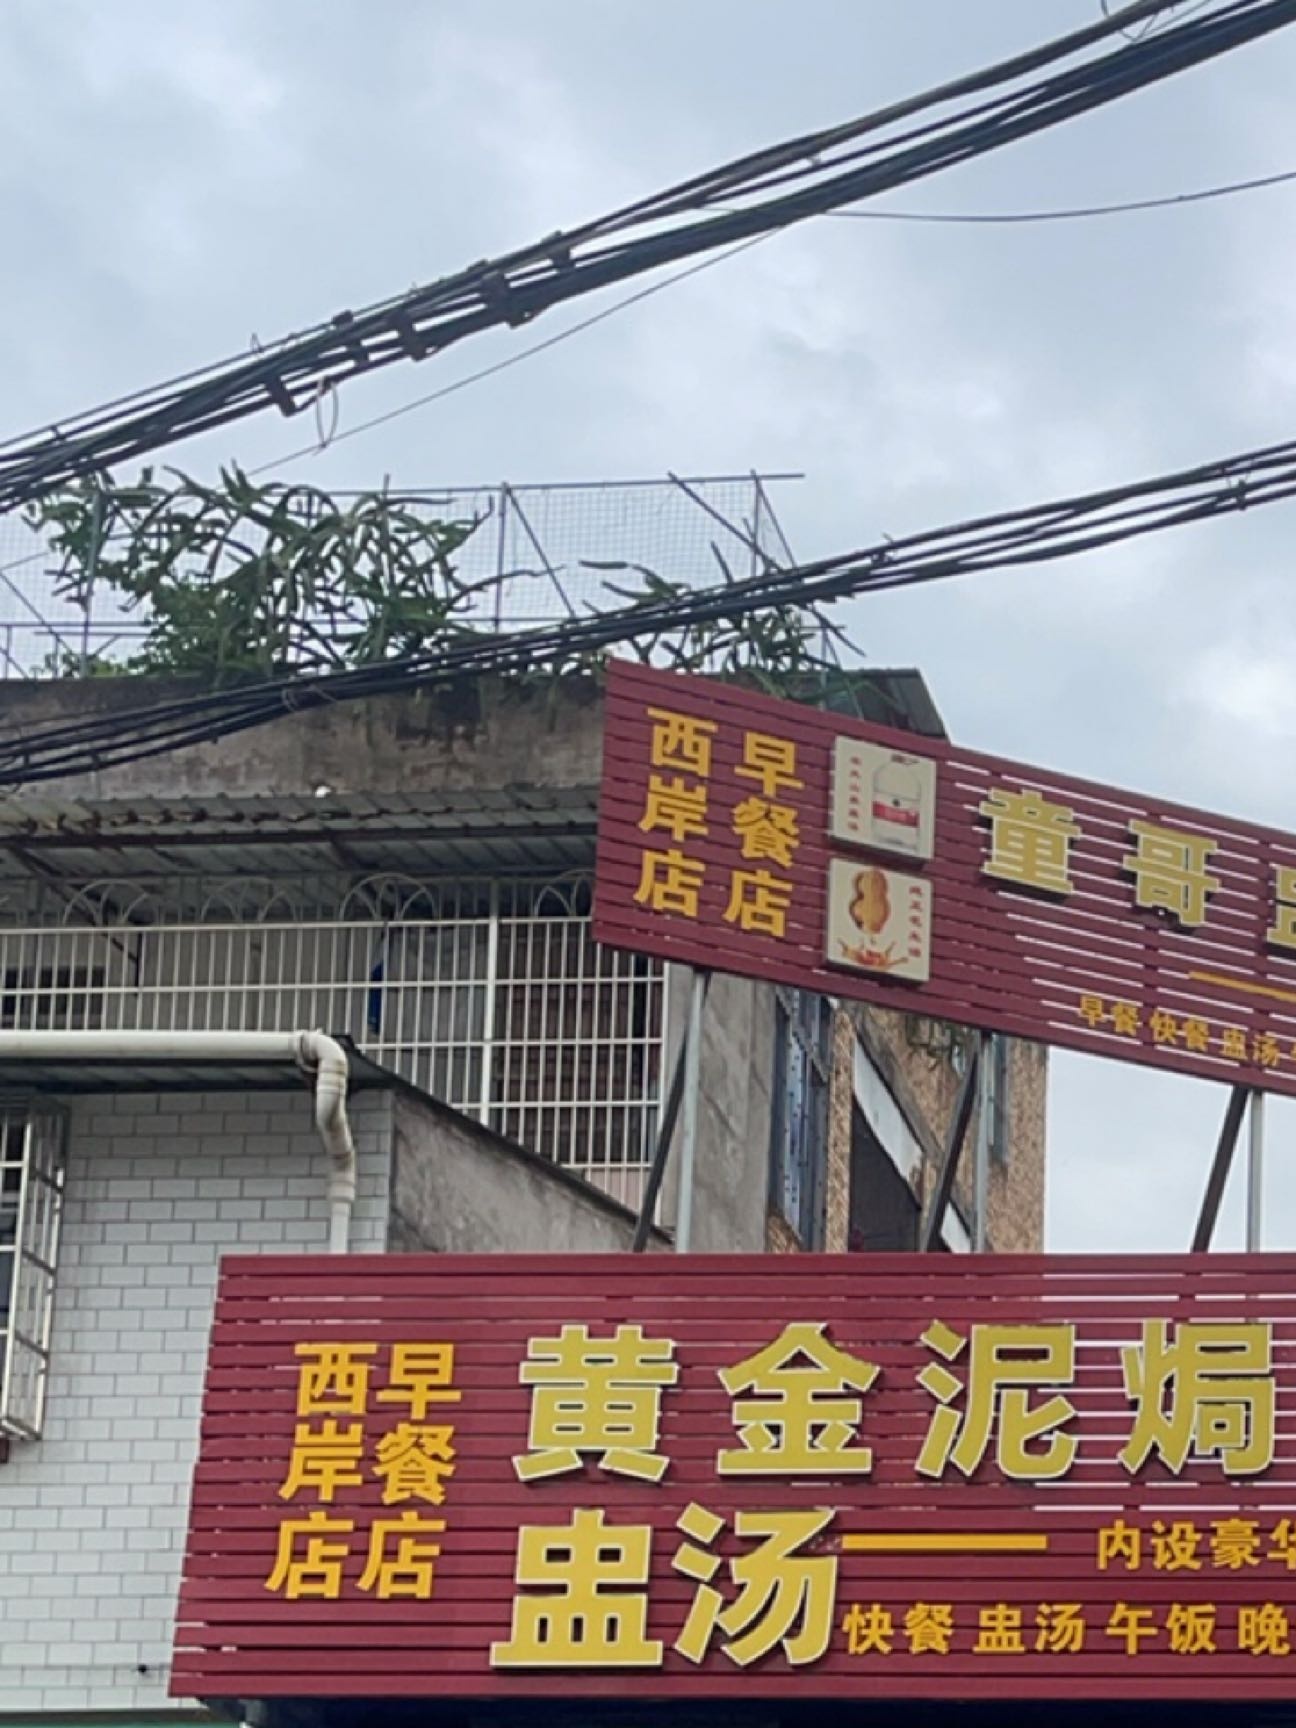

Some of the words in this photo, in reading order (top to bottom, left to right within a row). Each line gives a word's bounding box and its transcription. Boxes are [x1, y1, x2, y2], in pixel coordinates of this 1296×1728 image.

[634, 706, 718, 918] 西岸店
[723, 730, 805, 937] 早餐店
[1078, 994, 1138, 1037] 早餐
[1151, 1009, 1209, 1052] 快餐
[1222, 1027, 1281, 1068] 盅汤
[264, 1342, 378, 1600] 西岸店
[357, 1342, 463, 1600] 早餐店
[489, 1502, 839, 1668] 盅汤
[842, 1602, 955, 1657] 快餐
[972, 1602, 1087, 1655] 盅汤
[1106, 1602, 1217, 1656] 午饭
